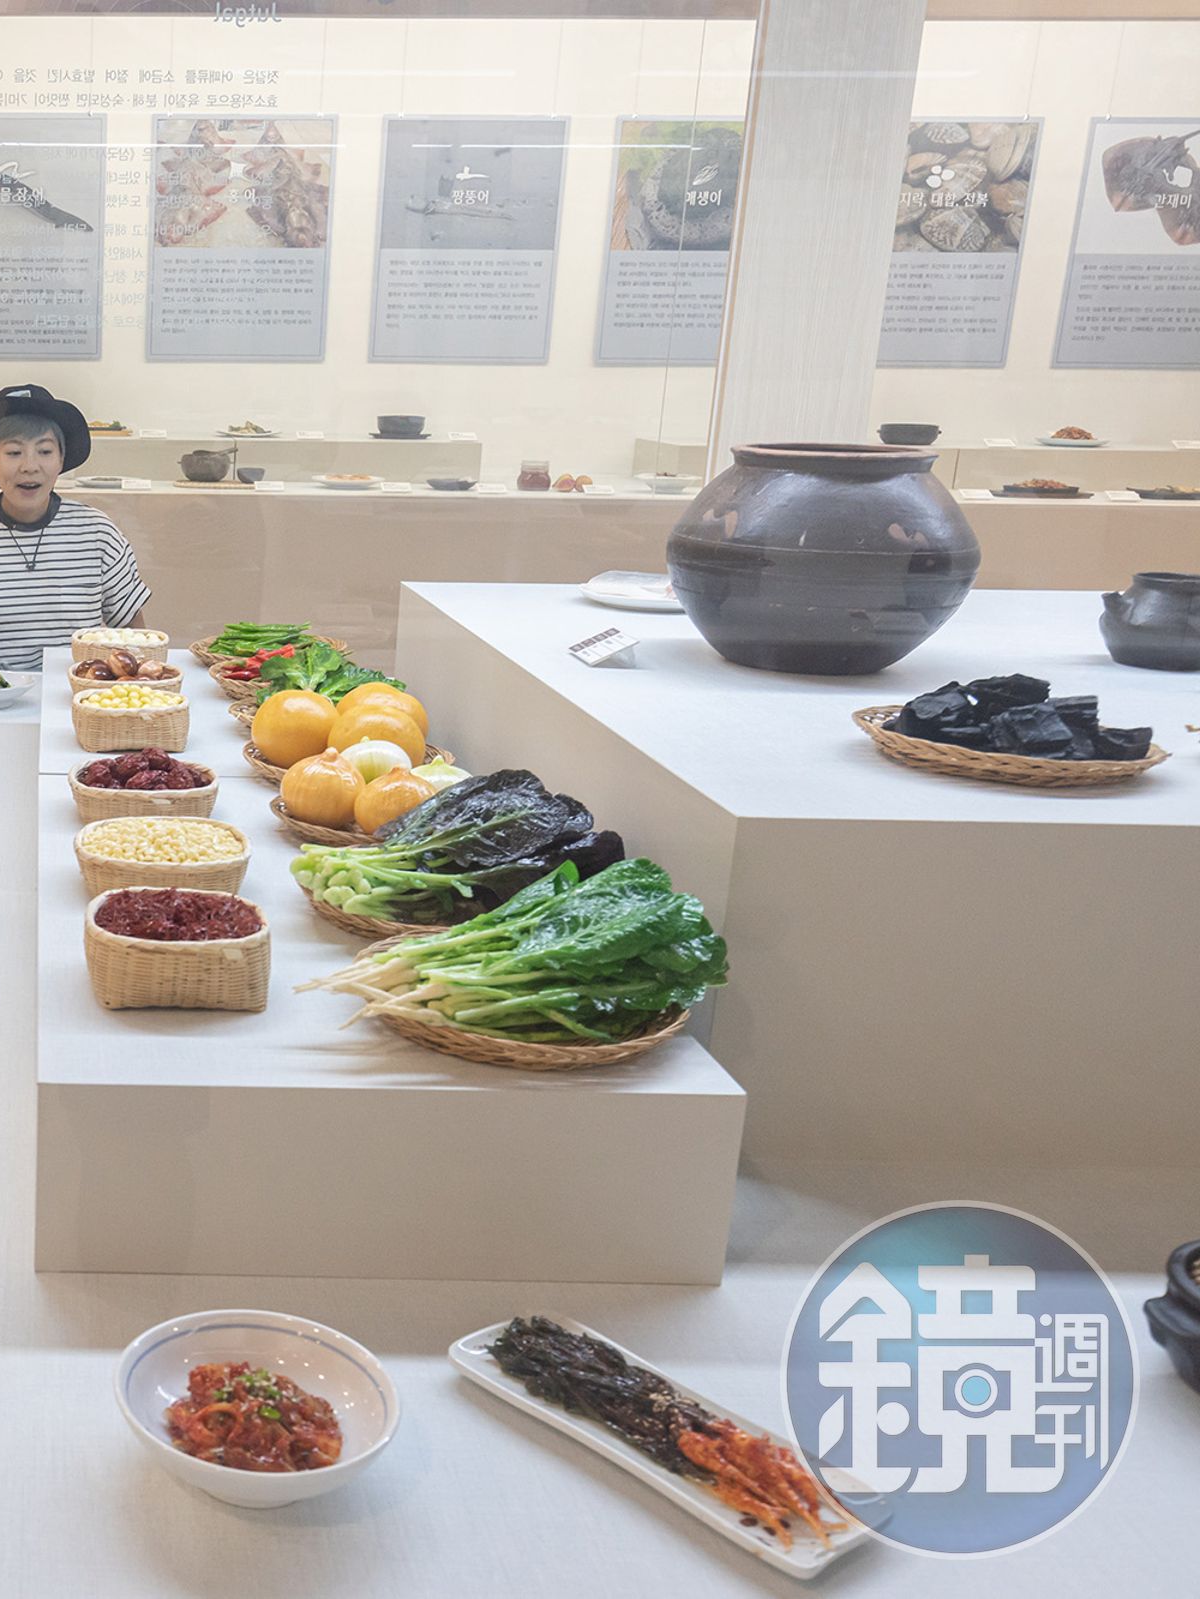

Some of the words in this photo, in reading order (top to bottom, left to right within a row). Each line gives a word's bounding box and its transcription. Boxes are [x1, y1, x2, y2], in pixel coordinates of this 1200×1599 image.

[451, 189, 490, 206] 짱뚱어
[963, 191, 990, 208] 전복
[1153, 193, 1193, 209] 간재미
